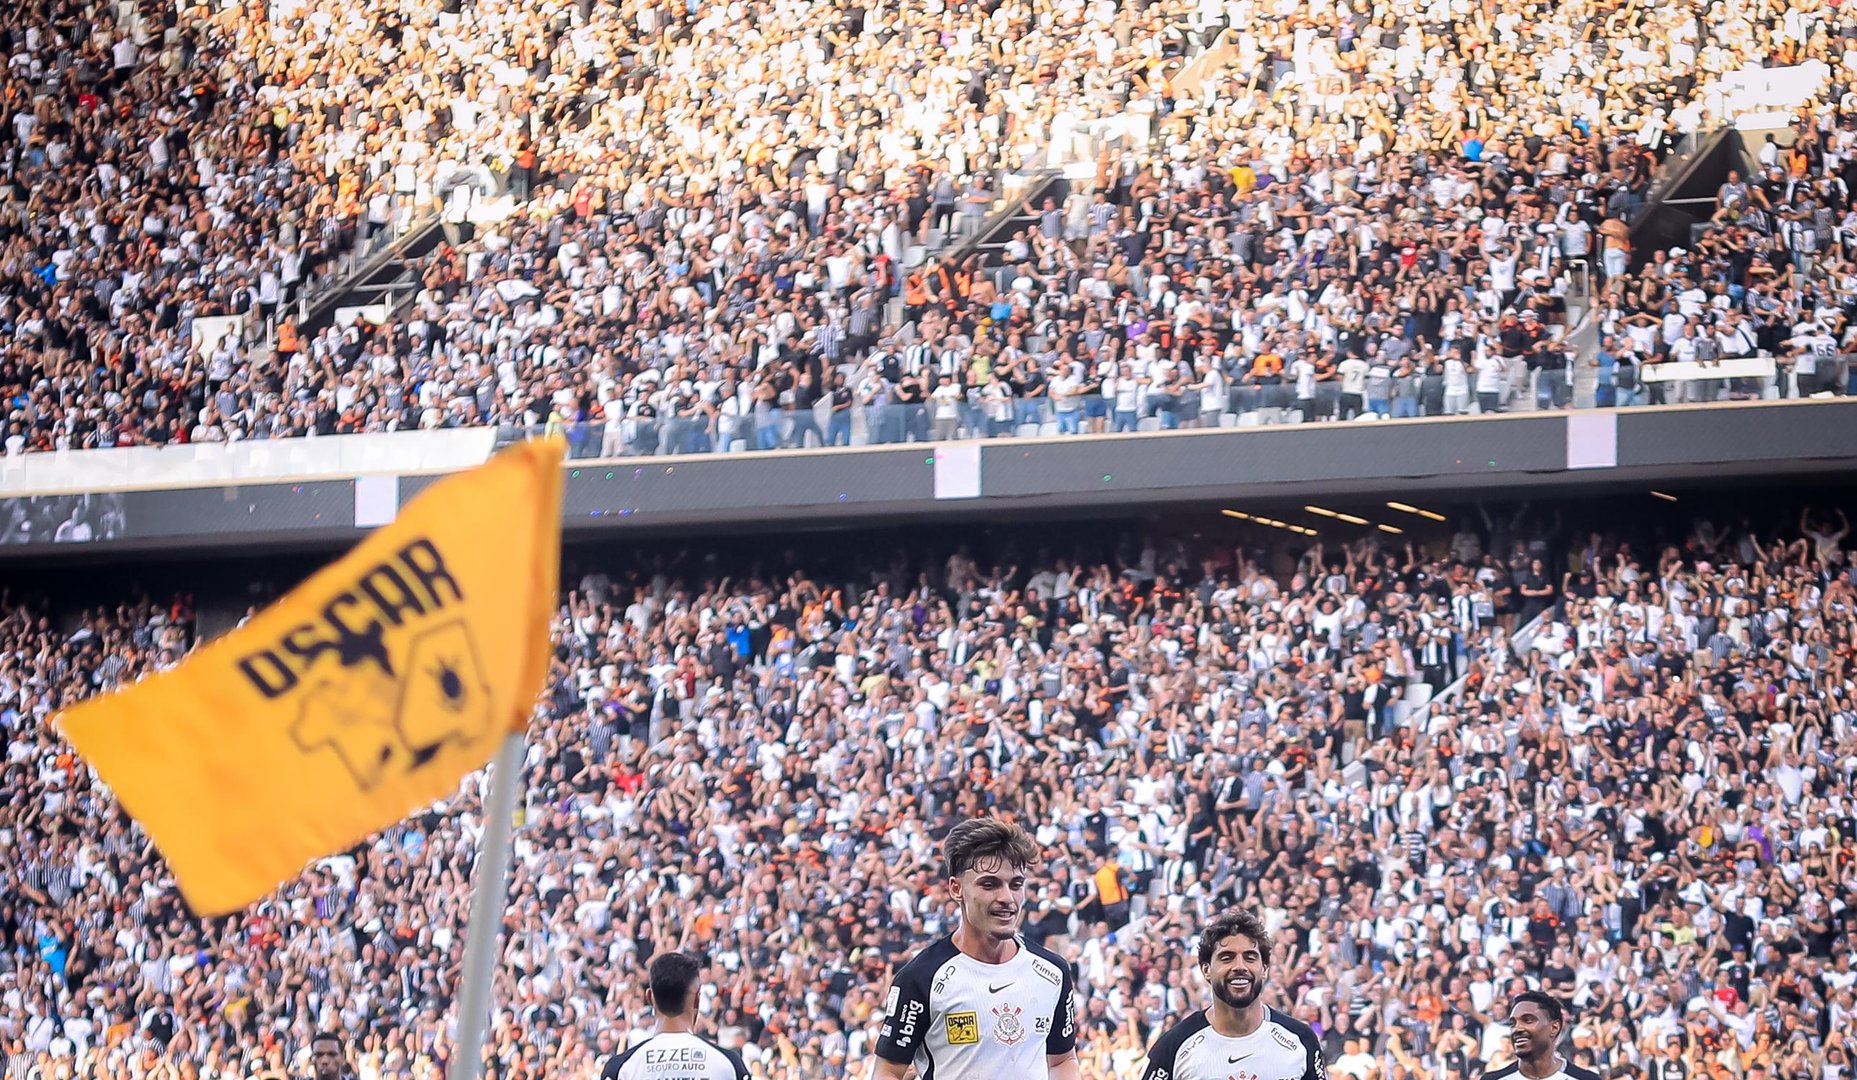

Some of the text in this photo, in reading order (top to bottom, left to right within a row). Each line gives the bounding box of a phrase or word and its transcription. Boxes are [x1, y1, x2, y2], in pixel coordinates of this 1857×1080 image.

[238, 538, 464, 699] OSCAR
[898, 999, 925, 1036] bmg
[645, 1048, 690, 1065] EZZE
[646, 1063, 706, 1074] SEGURO AUTO
